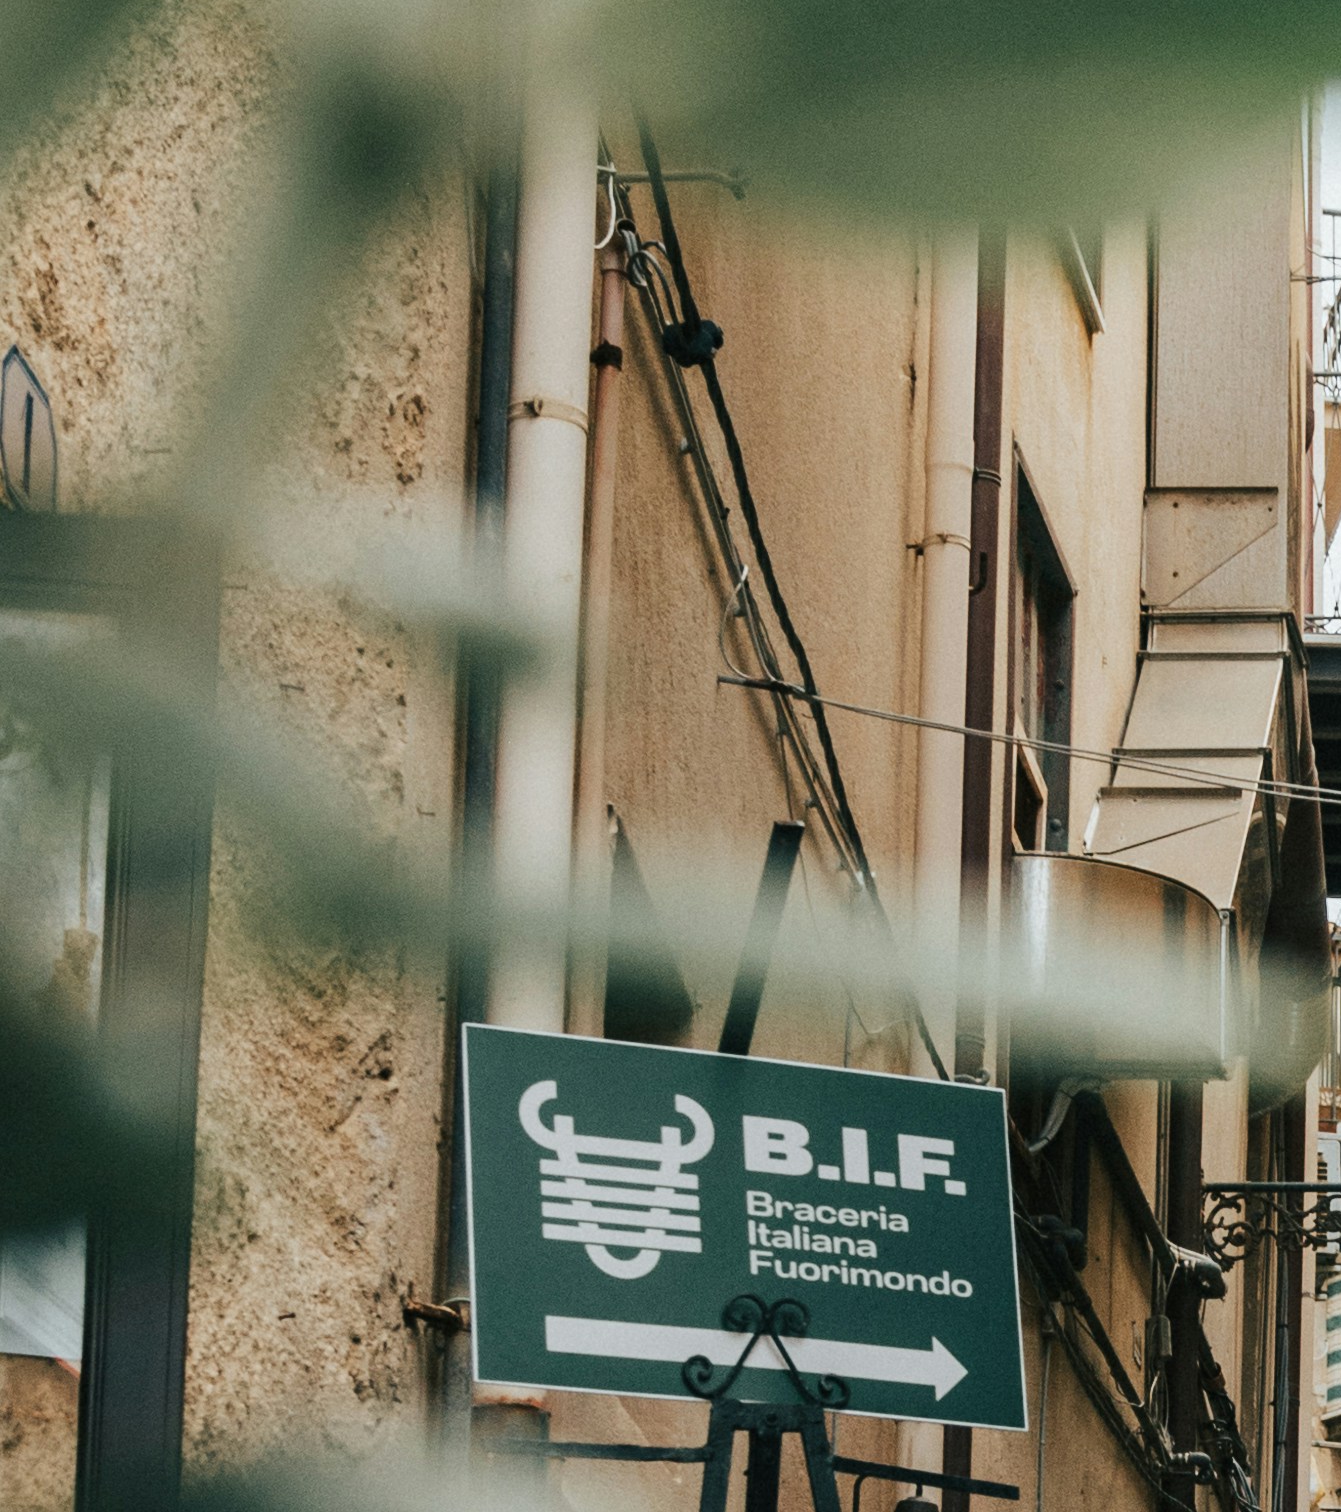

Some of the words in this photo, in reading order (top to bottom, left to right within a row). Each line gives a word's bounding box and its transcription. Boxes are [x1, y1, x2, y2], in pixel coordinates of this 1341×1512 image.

[742, 1114, 967, 1196] B.I.F.
[745, 1190, 910, 1233] Braceria
[747, 1220, 878, 1258] Italiana
[749, 1250, 973, 1298] Fuorimondo
